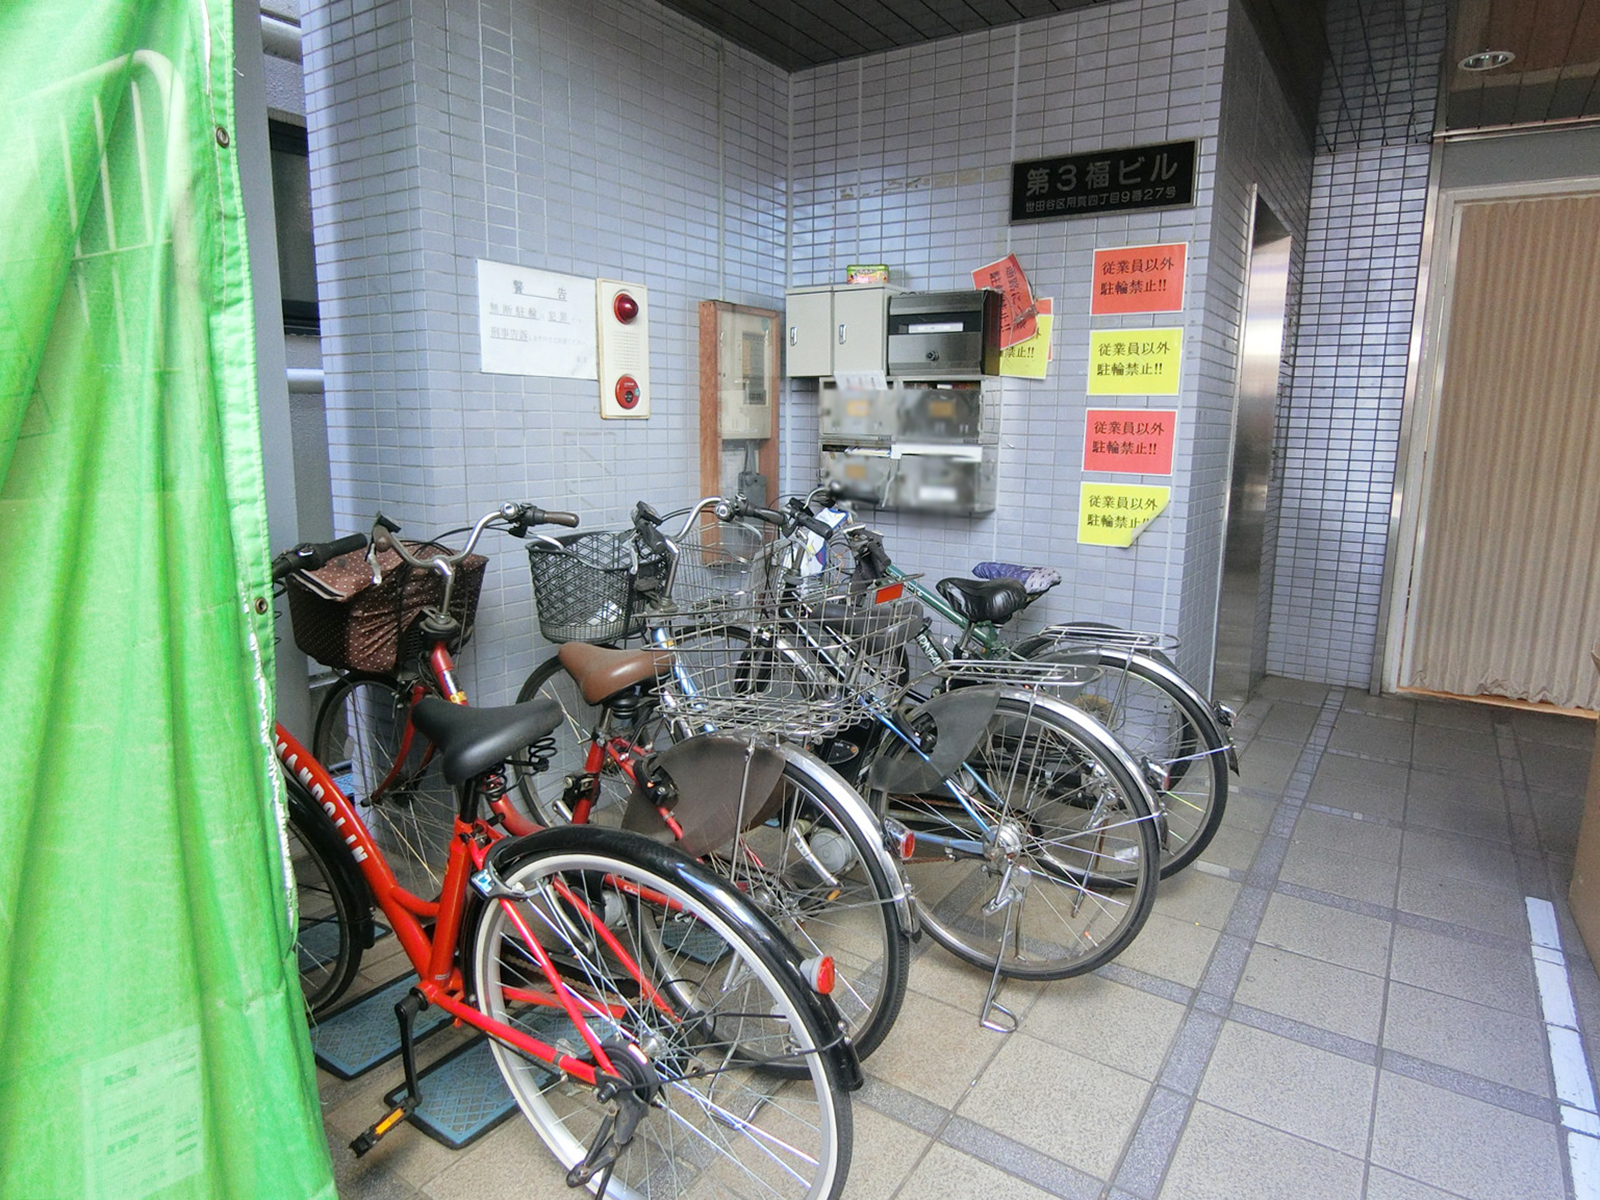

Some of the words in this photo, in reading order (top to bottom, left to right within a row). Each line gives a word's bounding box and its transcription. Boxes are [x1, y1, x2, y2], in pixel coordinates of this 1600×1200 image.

[1026, 153, 1178, 197] 第3福ビル
[1102, 257, 1174, 275] 従業員以外
[1100, 279, 1167, 296] 駐輪禁止!!
[1098, 341, 1170, 357] 従業員以外
[1097, 362, 1163, 377] 駐輪禁止!!
[1094, 421, 1164, 436] 従業員以外
[1092, 440, 1157, 455] 駐輪禁止!!
[1089, 495, 1158, 511] 従業員以外
